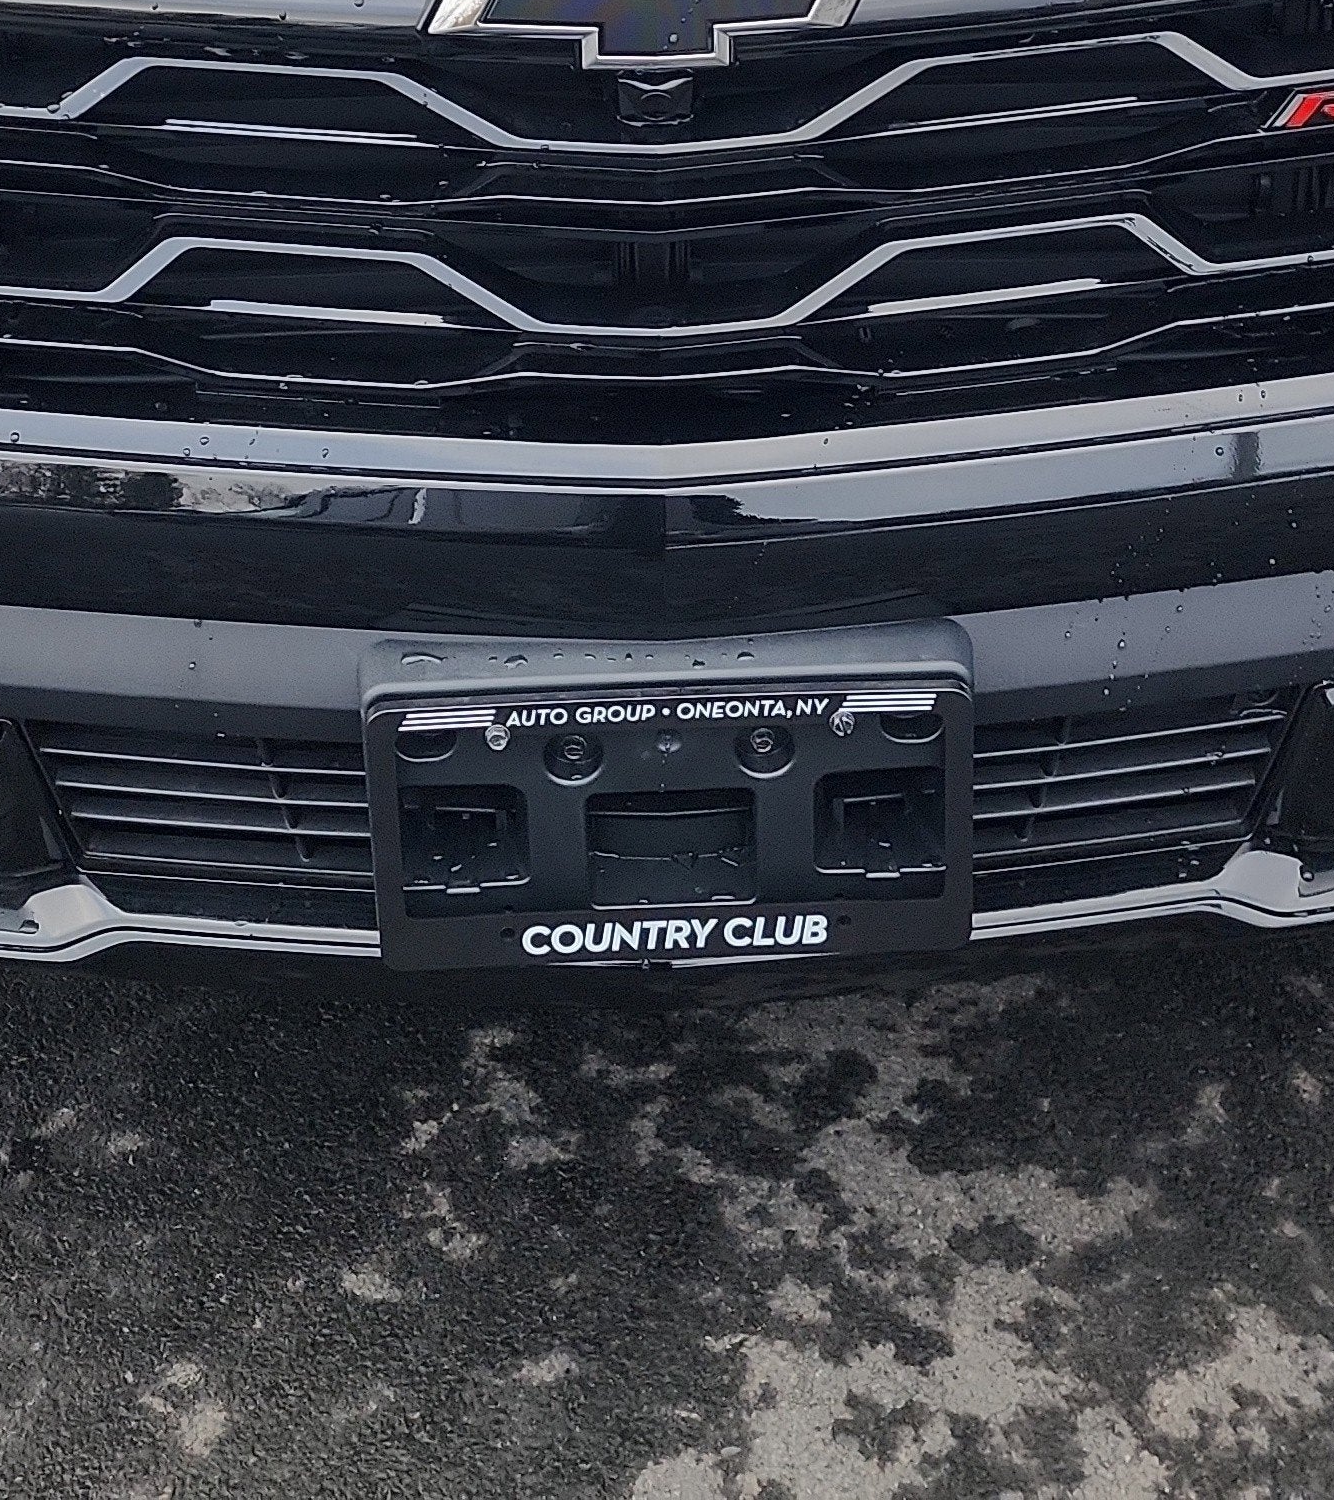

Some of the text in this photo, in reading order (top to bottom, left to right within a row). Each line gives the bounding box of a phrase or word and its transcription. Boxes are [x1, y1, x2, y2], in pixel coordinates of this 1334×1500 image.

[505, 707, 568, 728] AUTO
[575, 703, 656, 724] GROUP
[521, 913, 828, 956] COUNTRY CLUB
